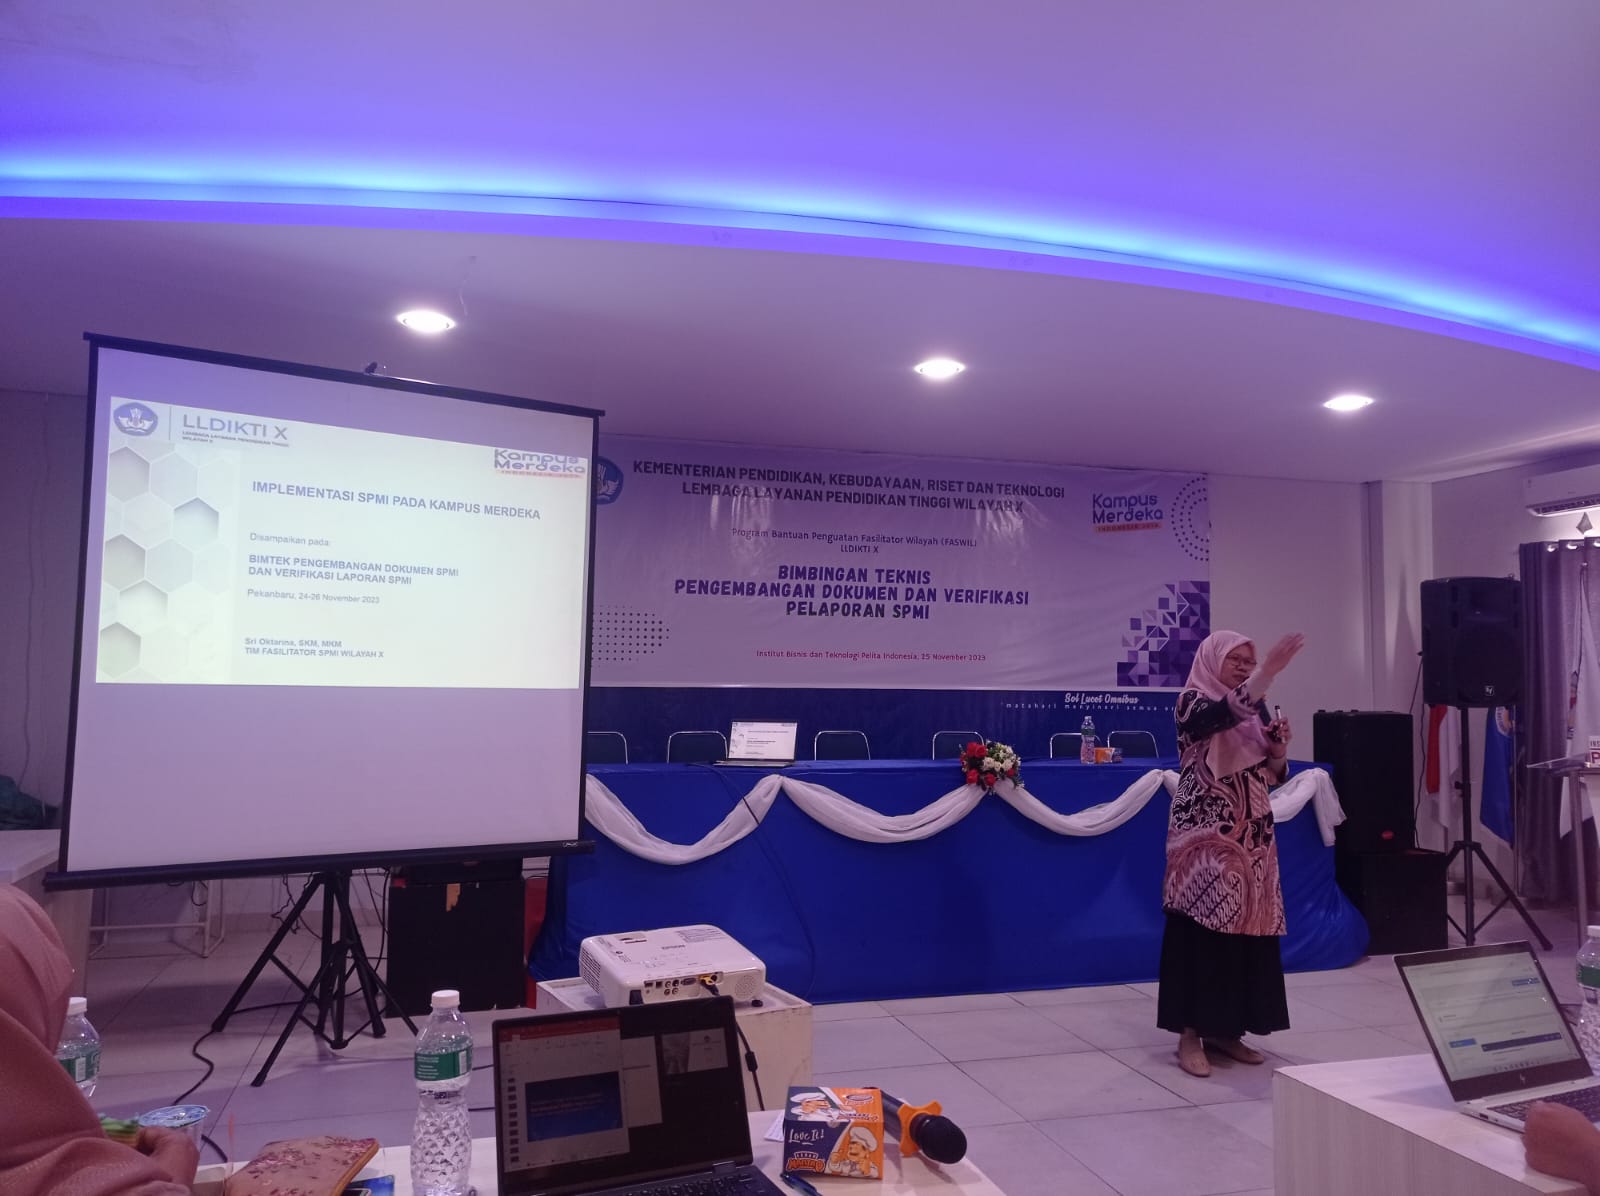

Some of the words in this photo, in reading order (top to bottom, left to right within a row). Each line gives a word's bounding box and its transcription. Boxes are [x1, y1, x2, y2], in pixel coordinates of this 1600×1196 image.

[183, 414, 268, 438] LLDIKTI
[274, 425, 288, 440] X
[494, 448, 578, 466] Kampus
[494, 459, 586, 473] Merdeka
[633, 460, 736, 479] KEMENTERIAN
[739, 467, 826, 486] PENDIDIKAN,
[829, 474, 924, 492] KEBUDAYAAN,
[927, 479, 964, 493] RISET
[966, 481, 993, 494] DAN
[996, 483, 1065, 498] TEKNOLOGI
[252, 480, 354, 502] IMPLEMENTASI
[358, 491, 389, 505] SPMI
[392, 495, 427, 508] PADA
[429, 499, 481, 514] KAMPUS
[484, 504, 541, 520] MERDEKA
[682, 482, 750, 498] LEMBAGA
[754, 486, 823, 503] LAYANAN
[826, 491, 906, 507] PENDIDIKAN
[909, 495, 950, 509] TINGGI
[953, 498, 1013, 513] WILAYAH
[1015, 501, 1023, 513] X
[1092, 493, 1158, 510] Kampus
[1092, 507, 1163, 524] Merdeka
[249, 532, 306, 545] Disampaikan
[732, 528, 769, 540] Program
[771, 529, 809, 540] Bantuan
[811, 531, 859, 544] Penguatan
[861, 534, 903, 544] Fasilitator
[905, 536, 938, 547] Wilayah
[873, 545, 879, 553] X
[248, 554, 291, 566] BIMTEK
[293, 557, 382, 572] PENGEMBANGAN
[384, 563, 434, 576] DOKUMEN
[436, 567, 459, 577] SPMI
[248, 566, 272, 576] DAN
[275, 568, 334, 580] VERIFIKASI
[336, 572, 386, 583] LAPORAN
[388, 575, 412, 585] SPMI
[778, 565, 868, 583] BIMBINGAN
[875, 568, 931, 585] TEKNIS
[247, 588, 297, 600] Pekanbaru,
[298, 591, 321, 600] 24-26
[322, 593, 360, 602] November
[361, 595, 380, 604] 2023
[674, 579, 815, 599] PENGEMBANGAN
[822, 584, 898, 601] DOKUMEN
[904, 587, 937, 602] DAN
[943, 588, 1029, 606] VERIFIKASI
[786, 601, 885, 618] PELAPORAN
[892, 603, 930, 620] SPMI
[245, 647, 260, 655] TIM
[262, 647, 316, 657] FASILITATOR
[319, 648, 339, 657] SPMI
[340, 650, 377, 658] WILAYAH
[786, 650, 808, 658] Bisnis
[825, 651, 860, 661] Teknologi
[1104, 693, 1139, 704] Omnibus
[788, 1128, 810, 1143] Love
[811, 1128, 825, 1141] It!
